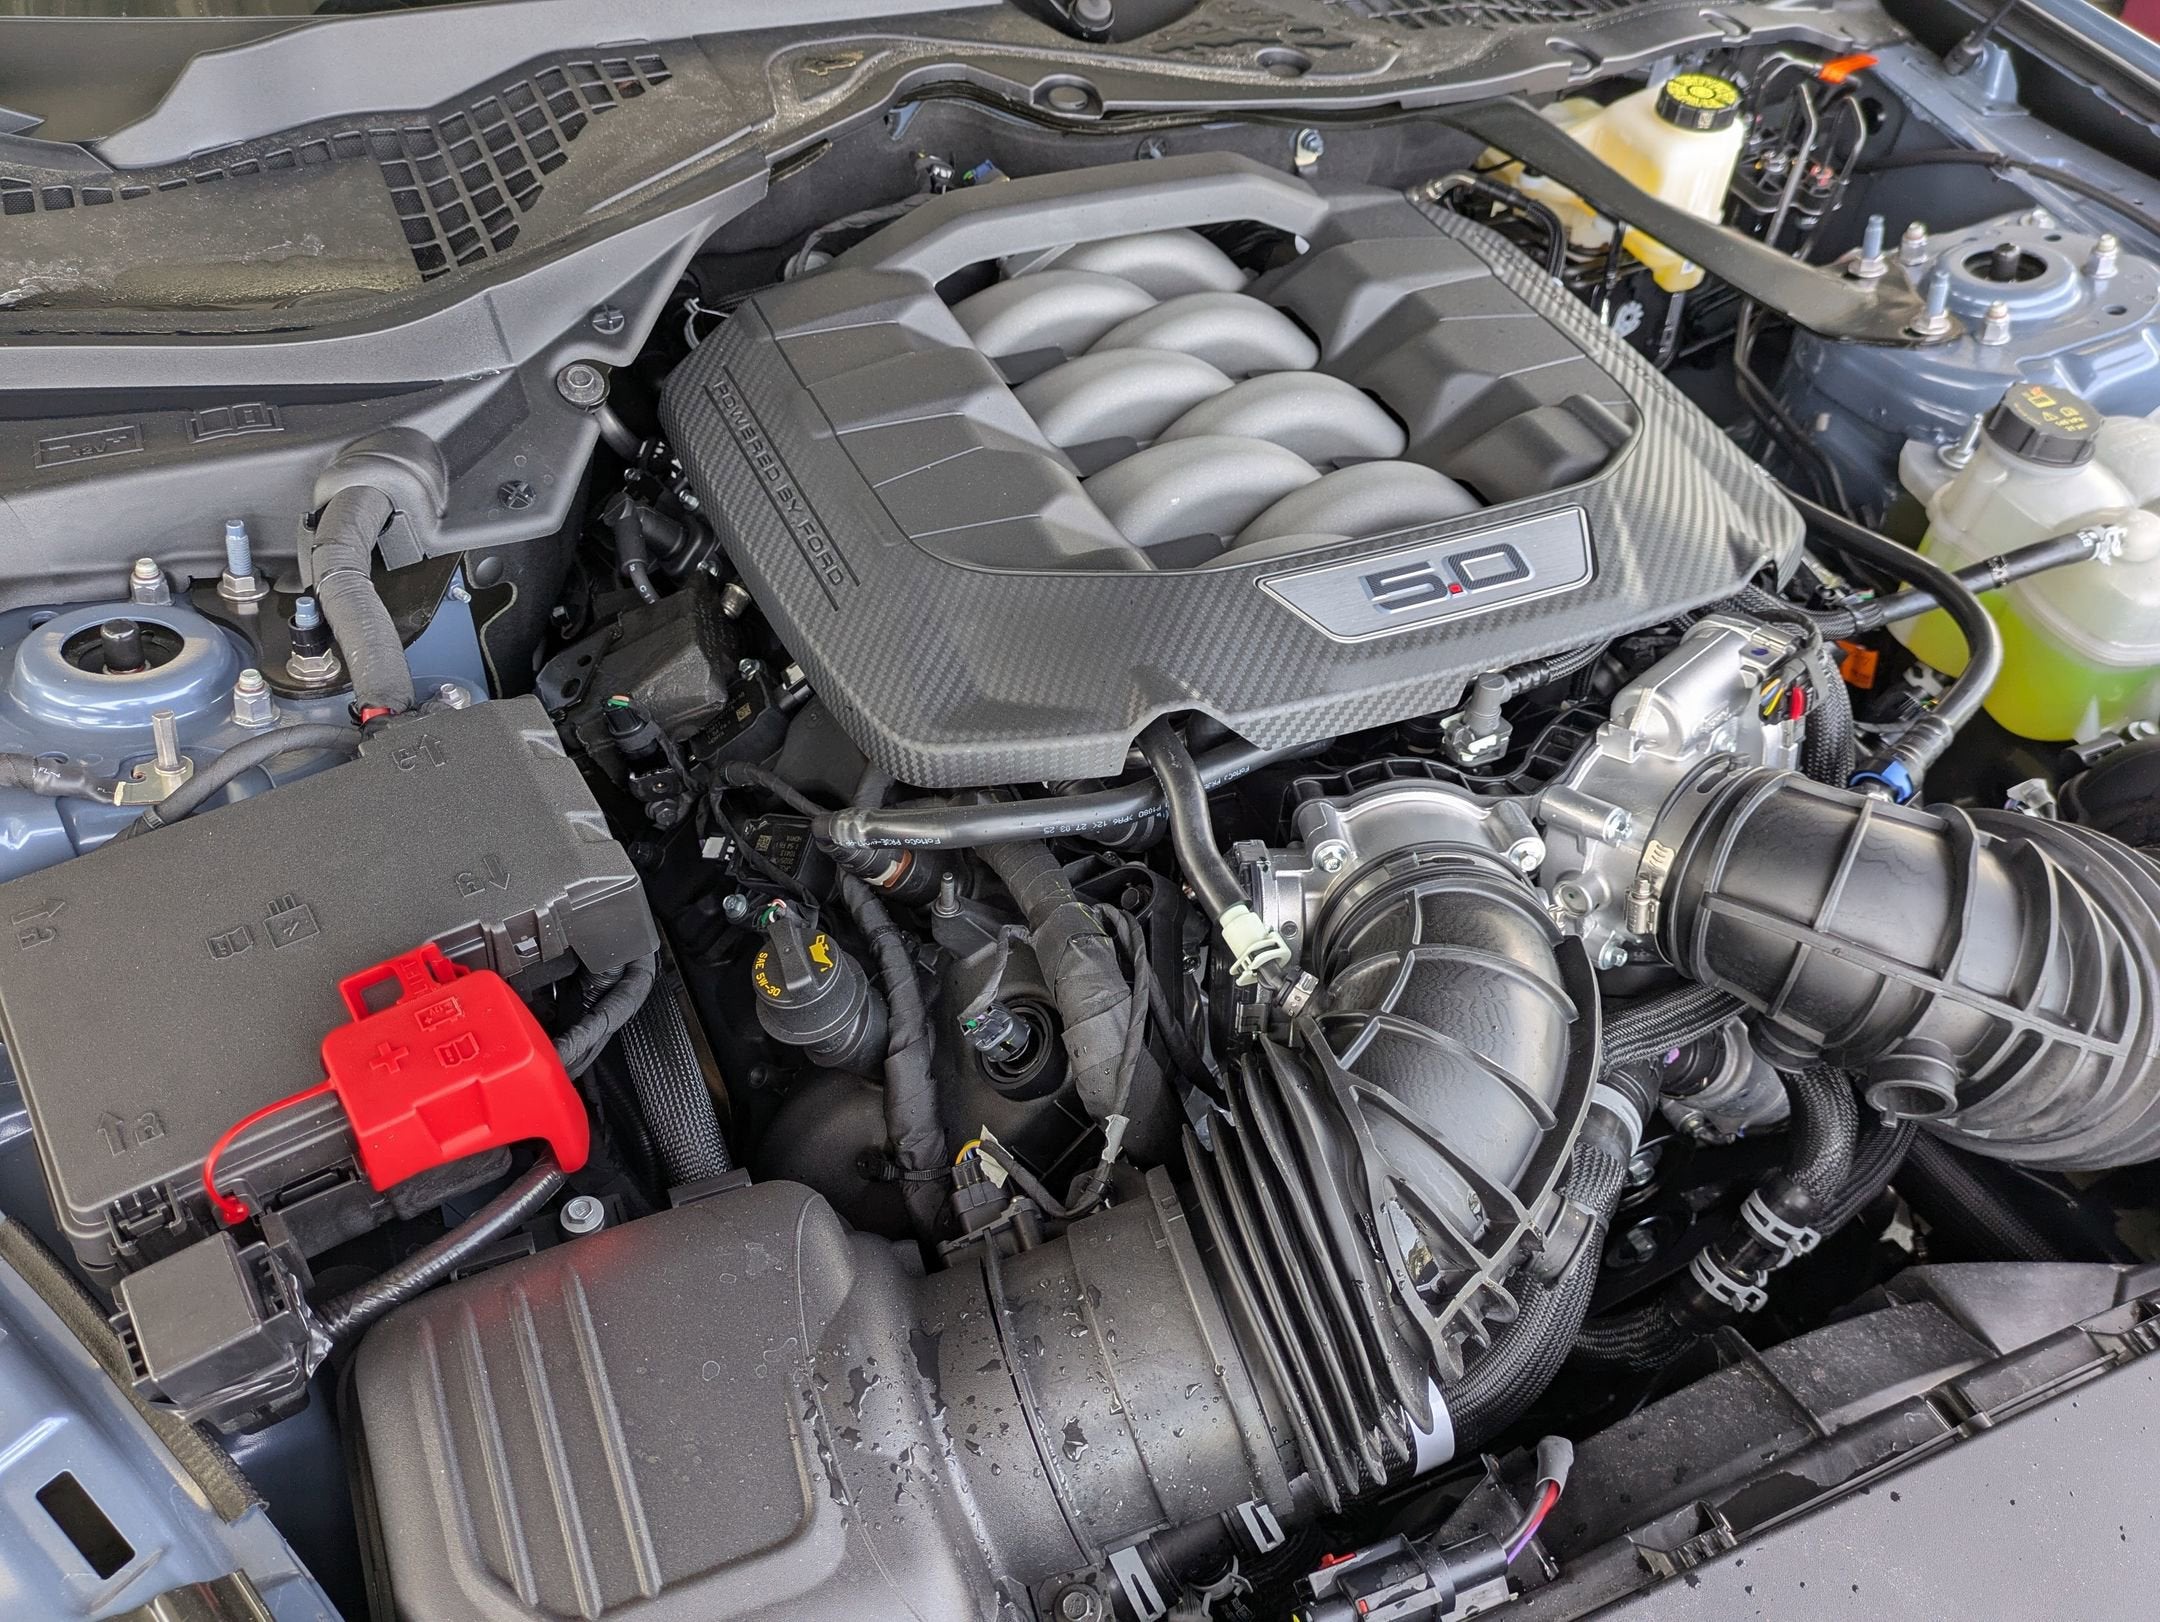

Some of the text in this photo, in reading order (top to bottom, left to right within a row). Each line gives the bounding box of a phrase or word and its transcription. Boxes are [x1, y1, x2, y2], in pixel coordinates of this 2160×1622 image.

[713, 380, 844, 586] POWERED BY FORD
[1358, 543, 1536, 614] 5.0
[904, 837, 942, 846] FoMoCo
[755, 952, 781, 997] SAE 5W-30
